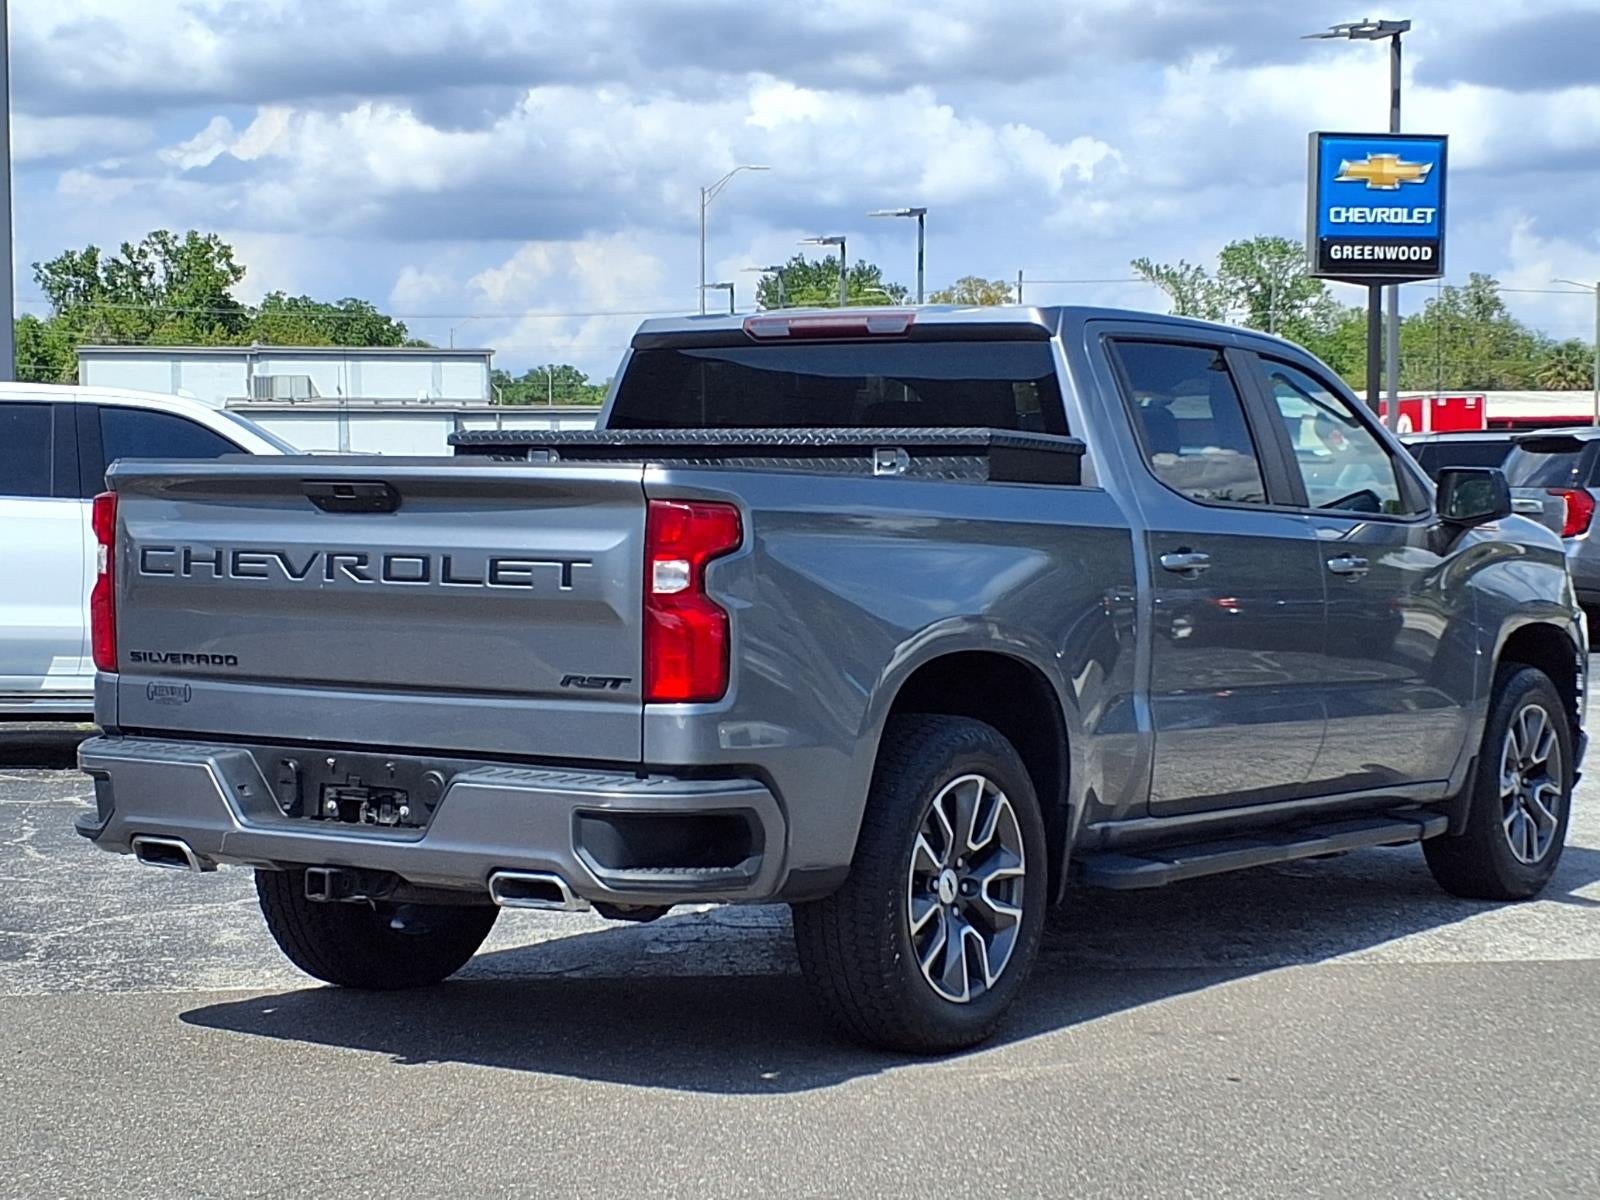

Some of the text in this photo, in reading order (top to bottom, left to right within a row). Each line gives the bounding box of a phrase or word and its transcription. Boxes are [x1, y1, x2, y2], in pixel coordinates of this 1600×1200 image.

[1329, 207, 1436, 223] CHEVROLET
[1330, 245, 1432, 261] GREENWOOD
[139, 545, 593, 590] CHEVROLET
[130, 651, 238, 666] SILVERADO
[560, 674, 633, 690] RST
